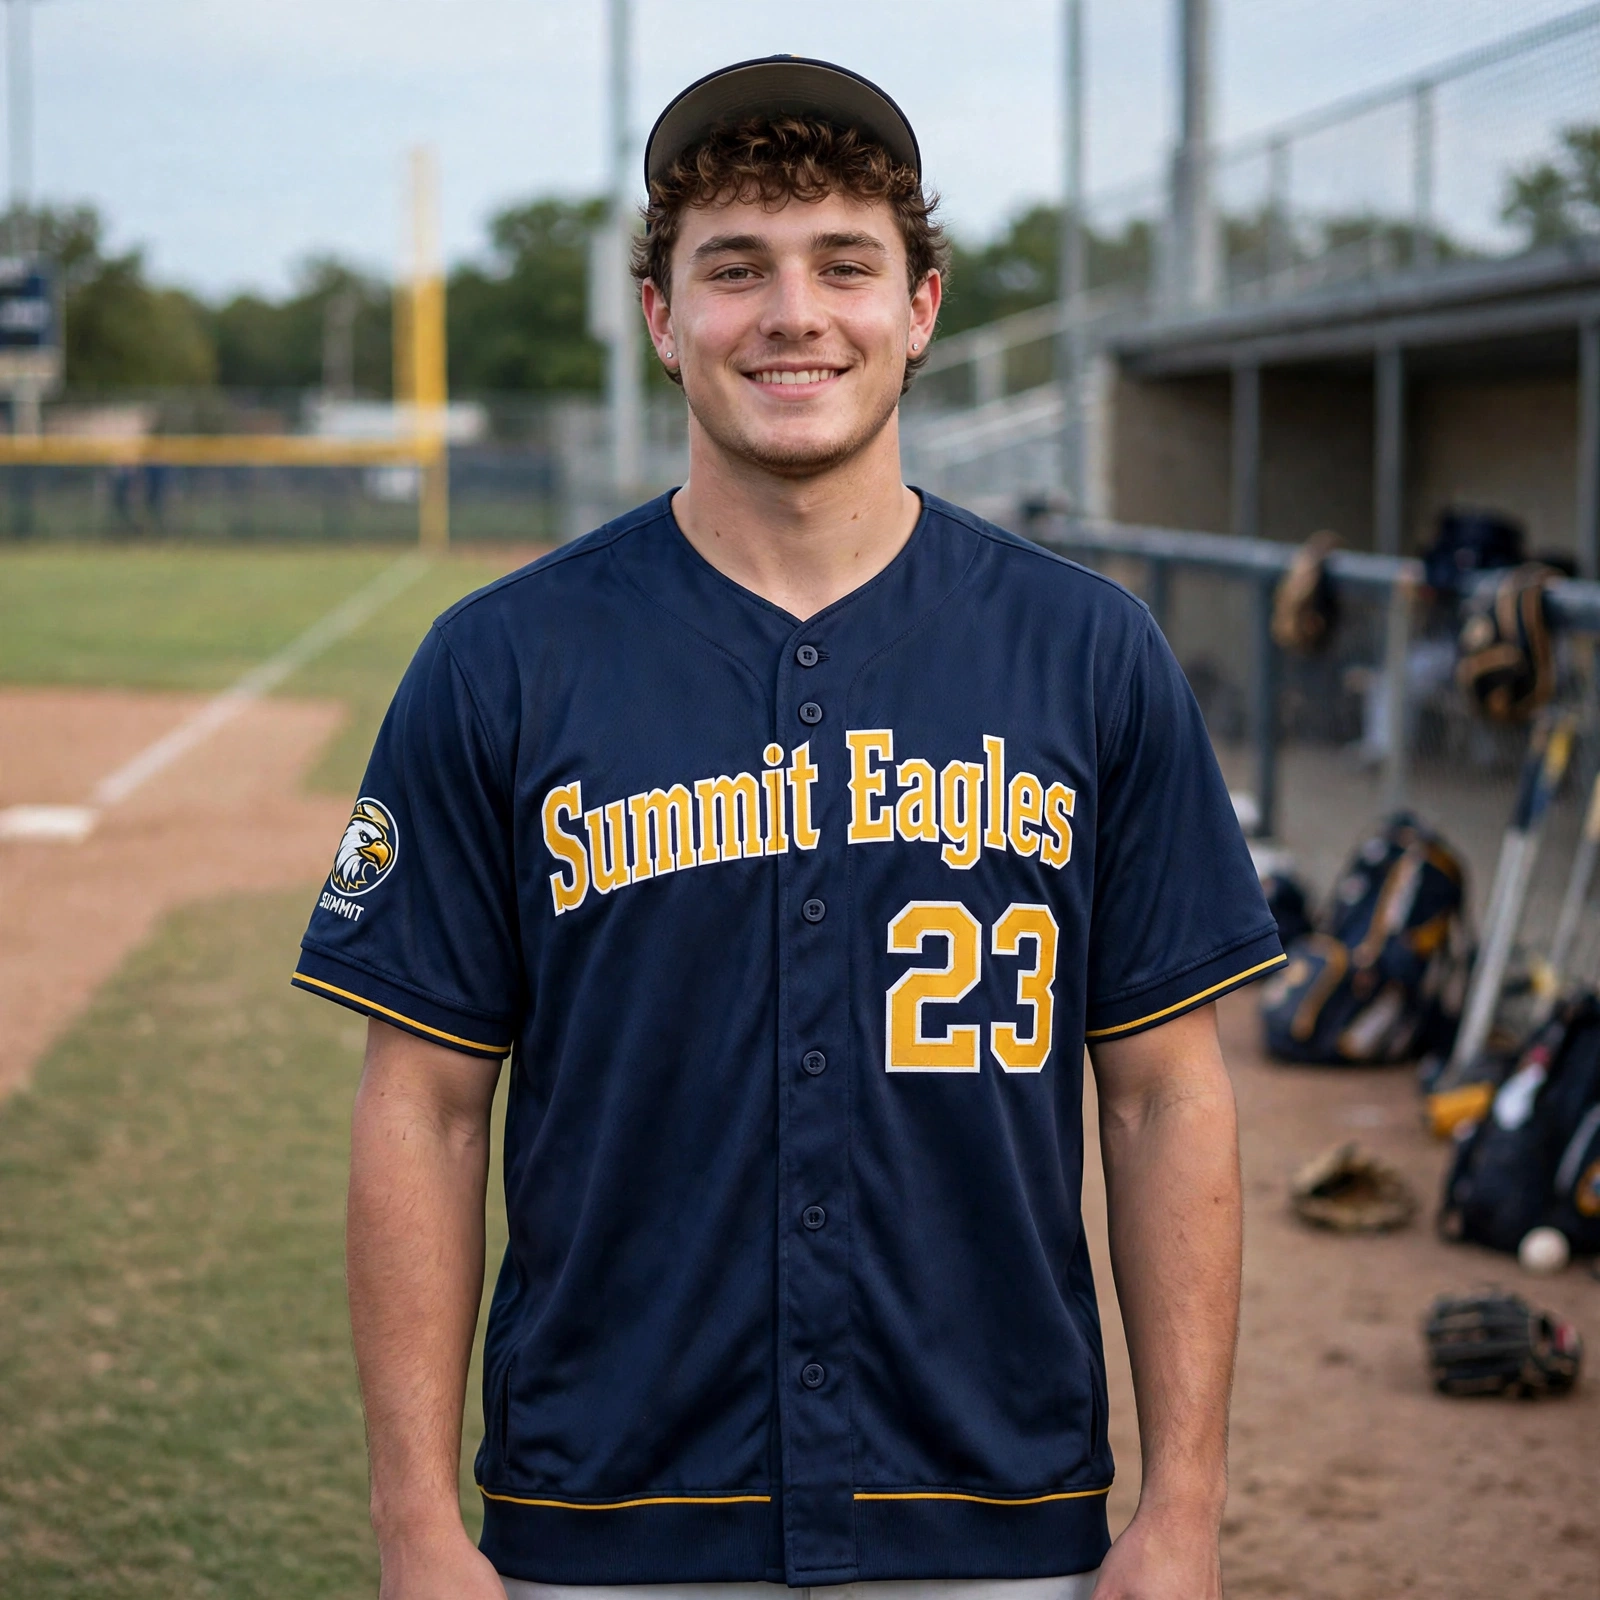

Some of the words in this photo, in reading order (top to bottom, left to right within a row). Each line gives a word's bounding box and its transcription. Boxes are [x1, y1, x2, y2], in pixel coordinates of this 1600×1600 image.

[319, 892, 365, 922] SUMMIT
[541, 741, 820, 916] Summit
[846, 729, 1076, 870] Eagles
[885, 901, 1059, 1073] 23
